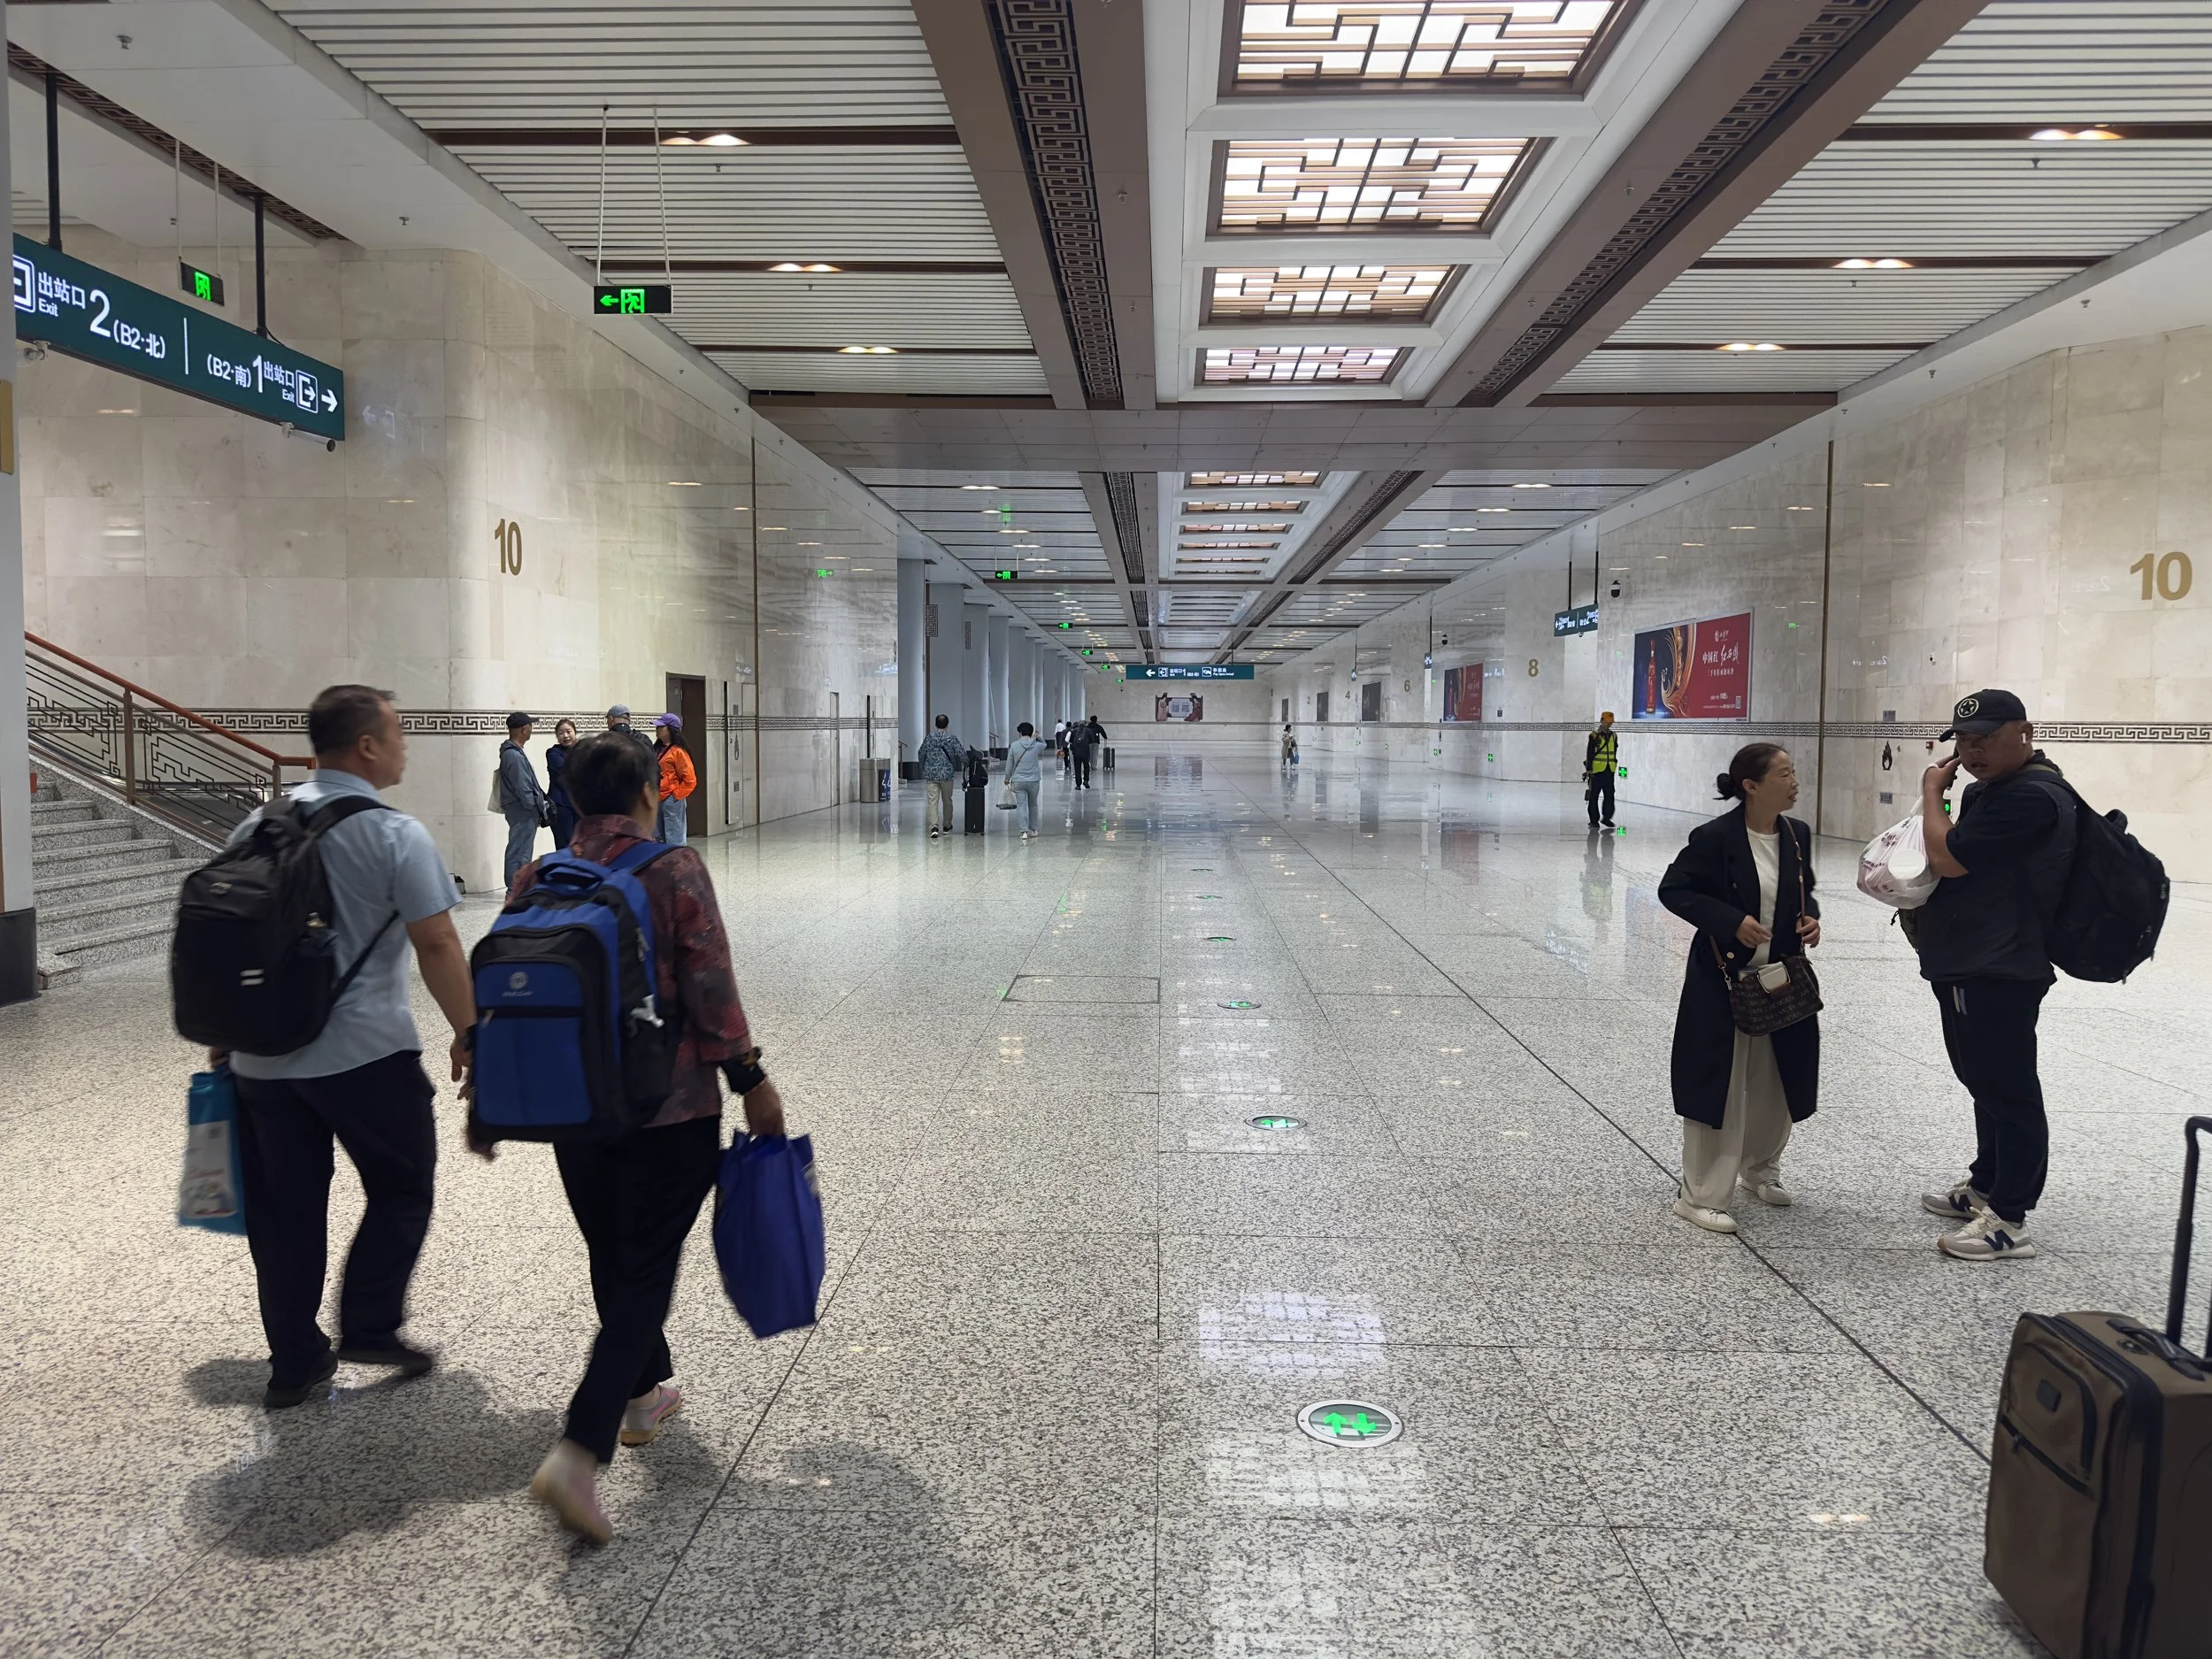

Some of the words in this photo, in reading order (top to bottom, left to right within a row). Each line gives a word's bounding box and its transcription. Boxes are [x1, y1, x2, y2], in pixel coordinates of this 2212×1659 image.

[38, 272, 86, 310] 出站口
[89, 289, 111, 338] 2
[38, 297, 59, 317] Exit
[252, 355, 263, 393] 1
[264, 361, 295, 388] 出站口
[282, 388, 295, 403] Exit
[494, 518, 523, 576] 10
[2130, 551, 2193, 601] 10
[1528, 658, 1539, 678] 8
[1345, 690, 1351, 700] 4
[1403, 680, 1410, 693] 6
[1307, 696, 1311, 705] 2
